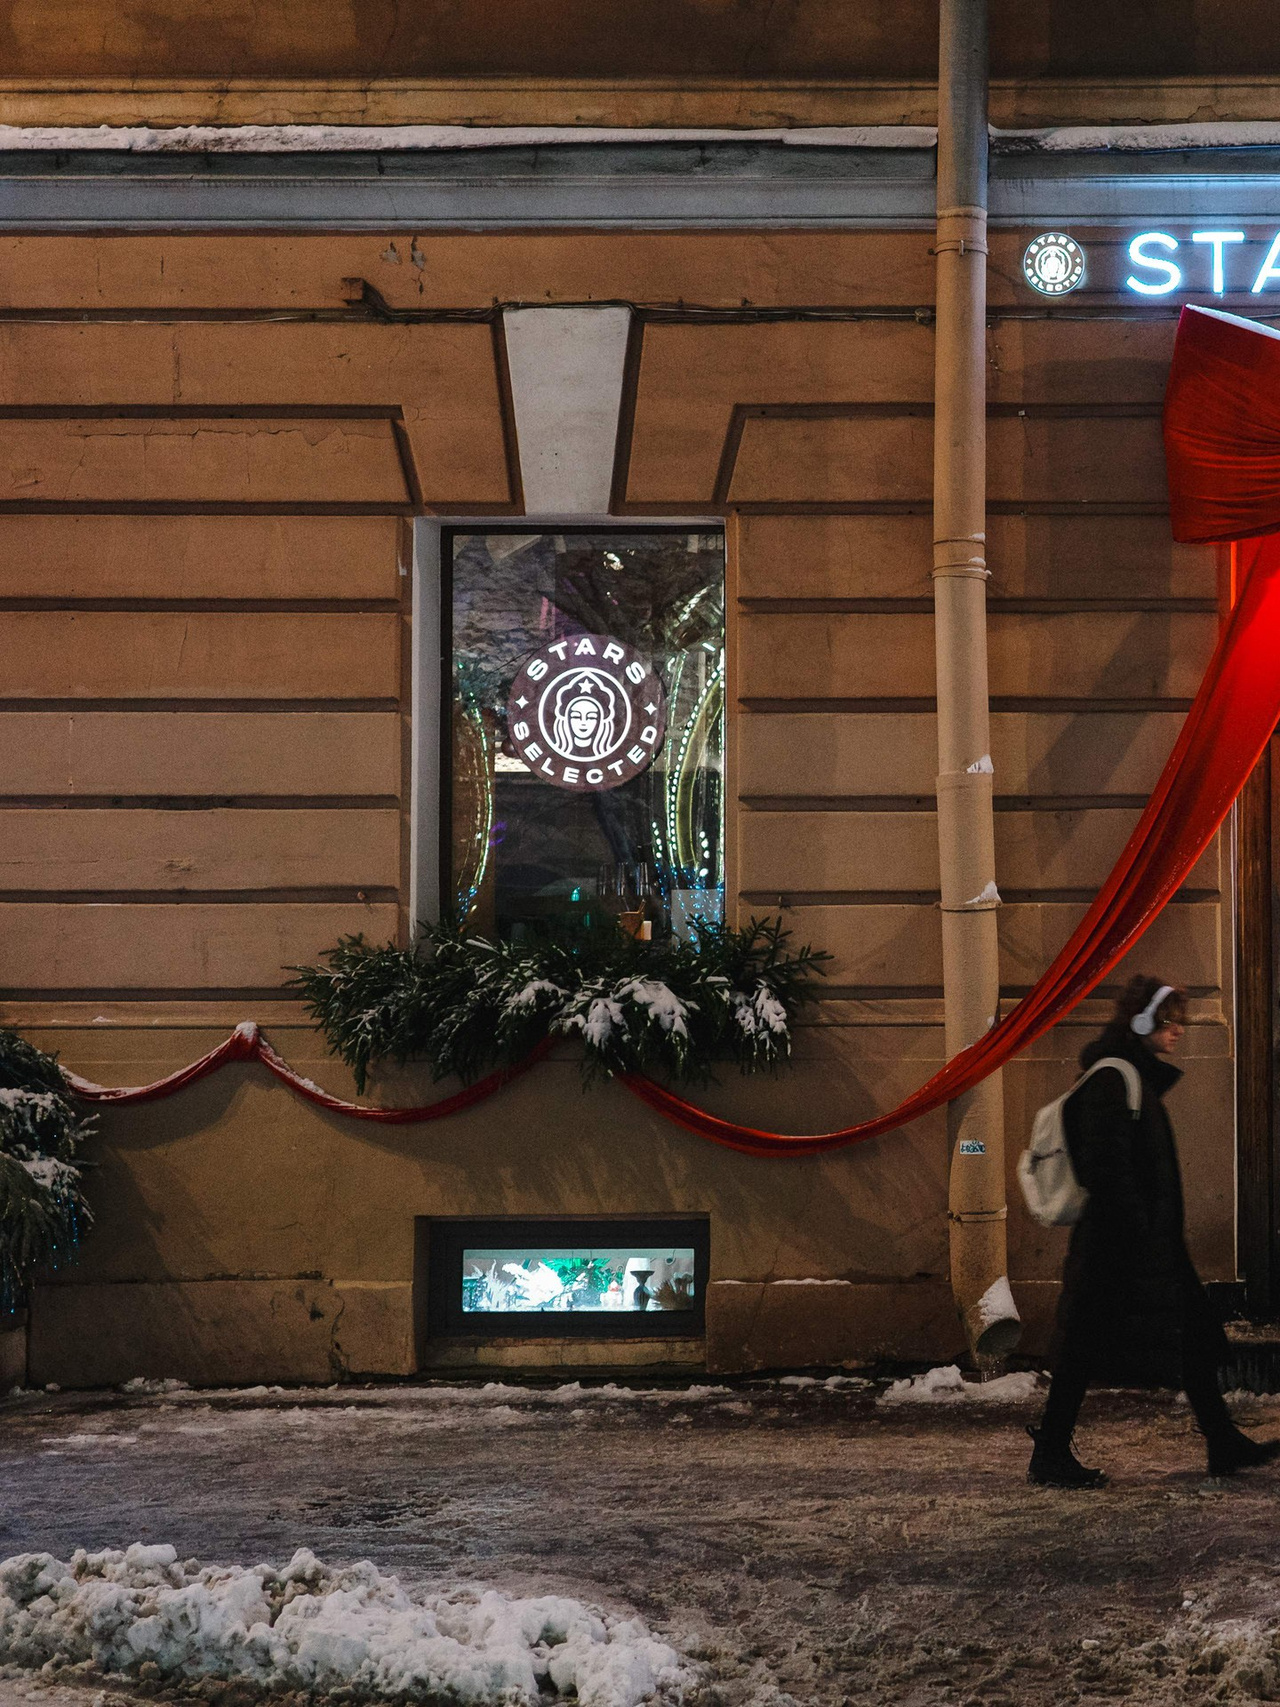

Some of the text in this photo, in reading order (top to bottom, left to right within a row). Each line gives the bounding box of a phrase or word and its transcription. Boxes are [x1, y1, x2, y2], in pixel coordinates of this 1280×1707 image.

[1029, 234, 1076, 254] STARS
[1026, 265, 1082, 292] SELECTED
[526, 638, 646, 685] STARS
[513, 721, 658, 784] SELECTED
